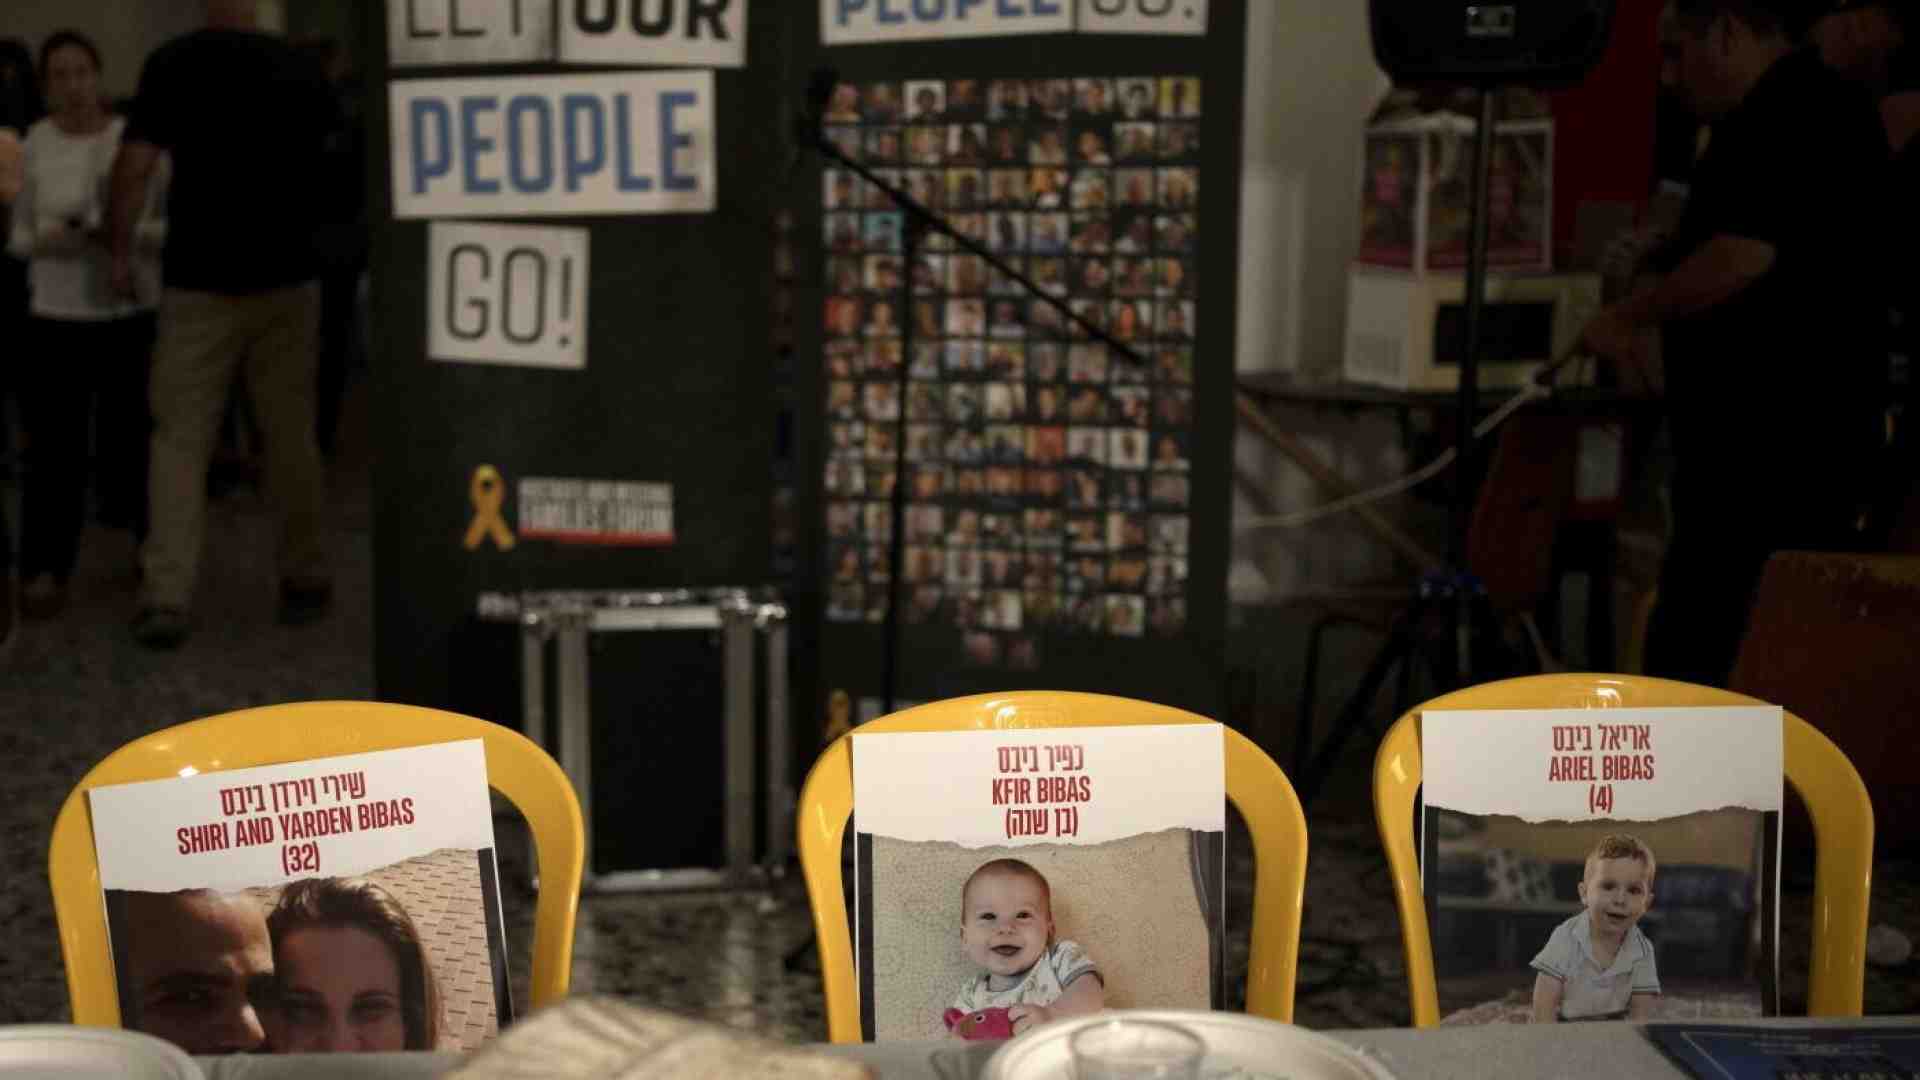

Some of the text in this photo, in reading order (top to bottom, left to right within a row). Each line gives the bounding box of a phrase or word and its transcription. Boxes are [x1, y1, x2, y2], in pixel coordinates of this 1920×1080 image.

[409, 92, 698, 195] PEOPLE
[446, 243, 573, 349] GO!
[1552, 724, 1651, 752] אריאל ביבס
[996, 745, 1083, 773] כפיר ביבס
[1549, 755, 1654, 781] ARIEL BIBAS
[219, 771, 366, 816] שירי וירדן ביבס
[992, 776, 1091, 805] KFIR BIBAS
[1589, 784, 1613, 814] (4)
[177, 797, 415, 855] SHIRI AND YARDEN BIBAS
[281, 841, 321, 876] (32)
